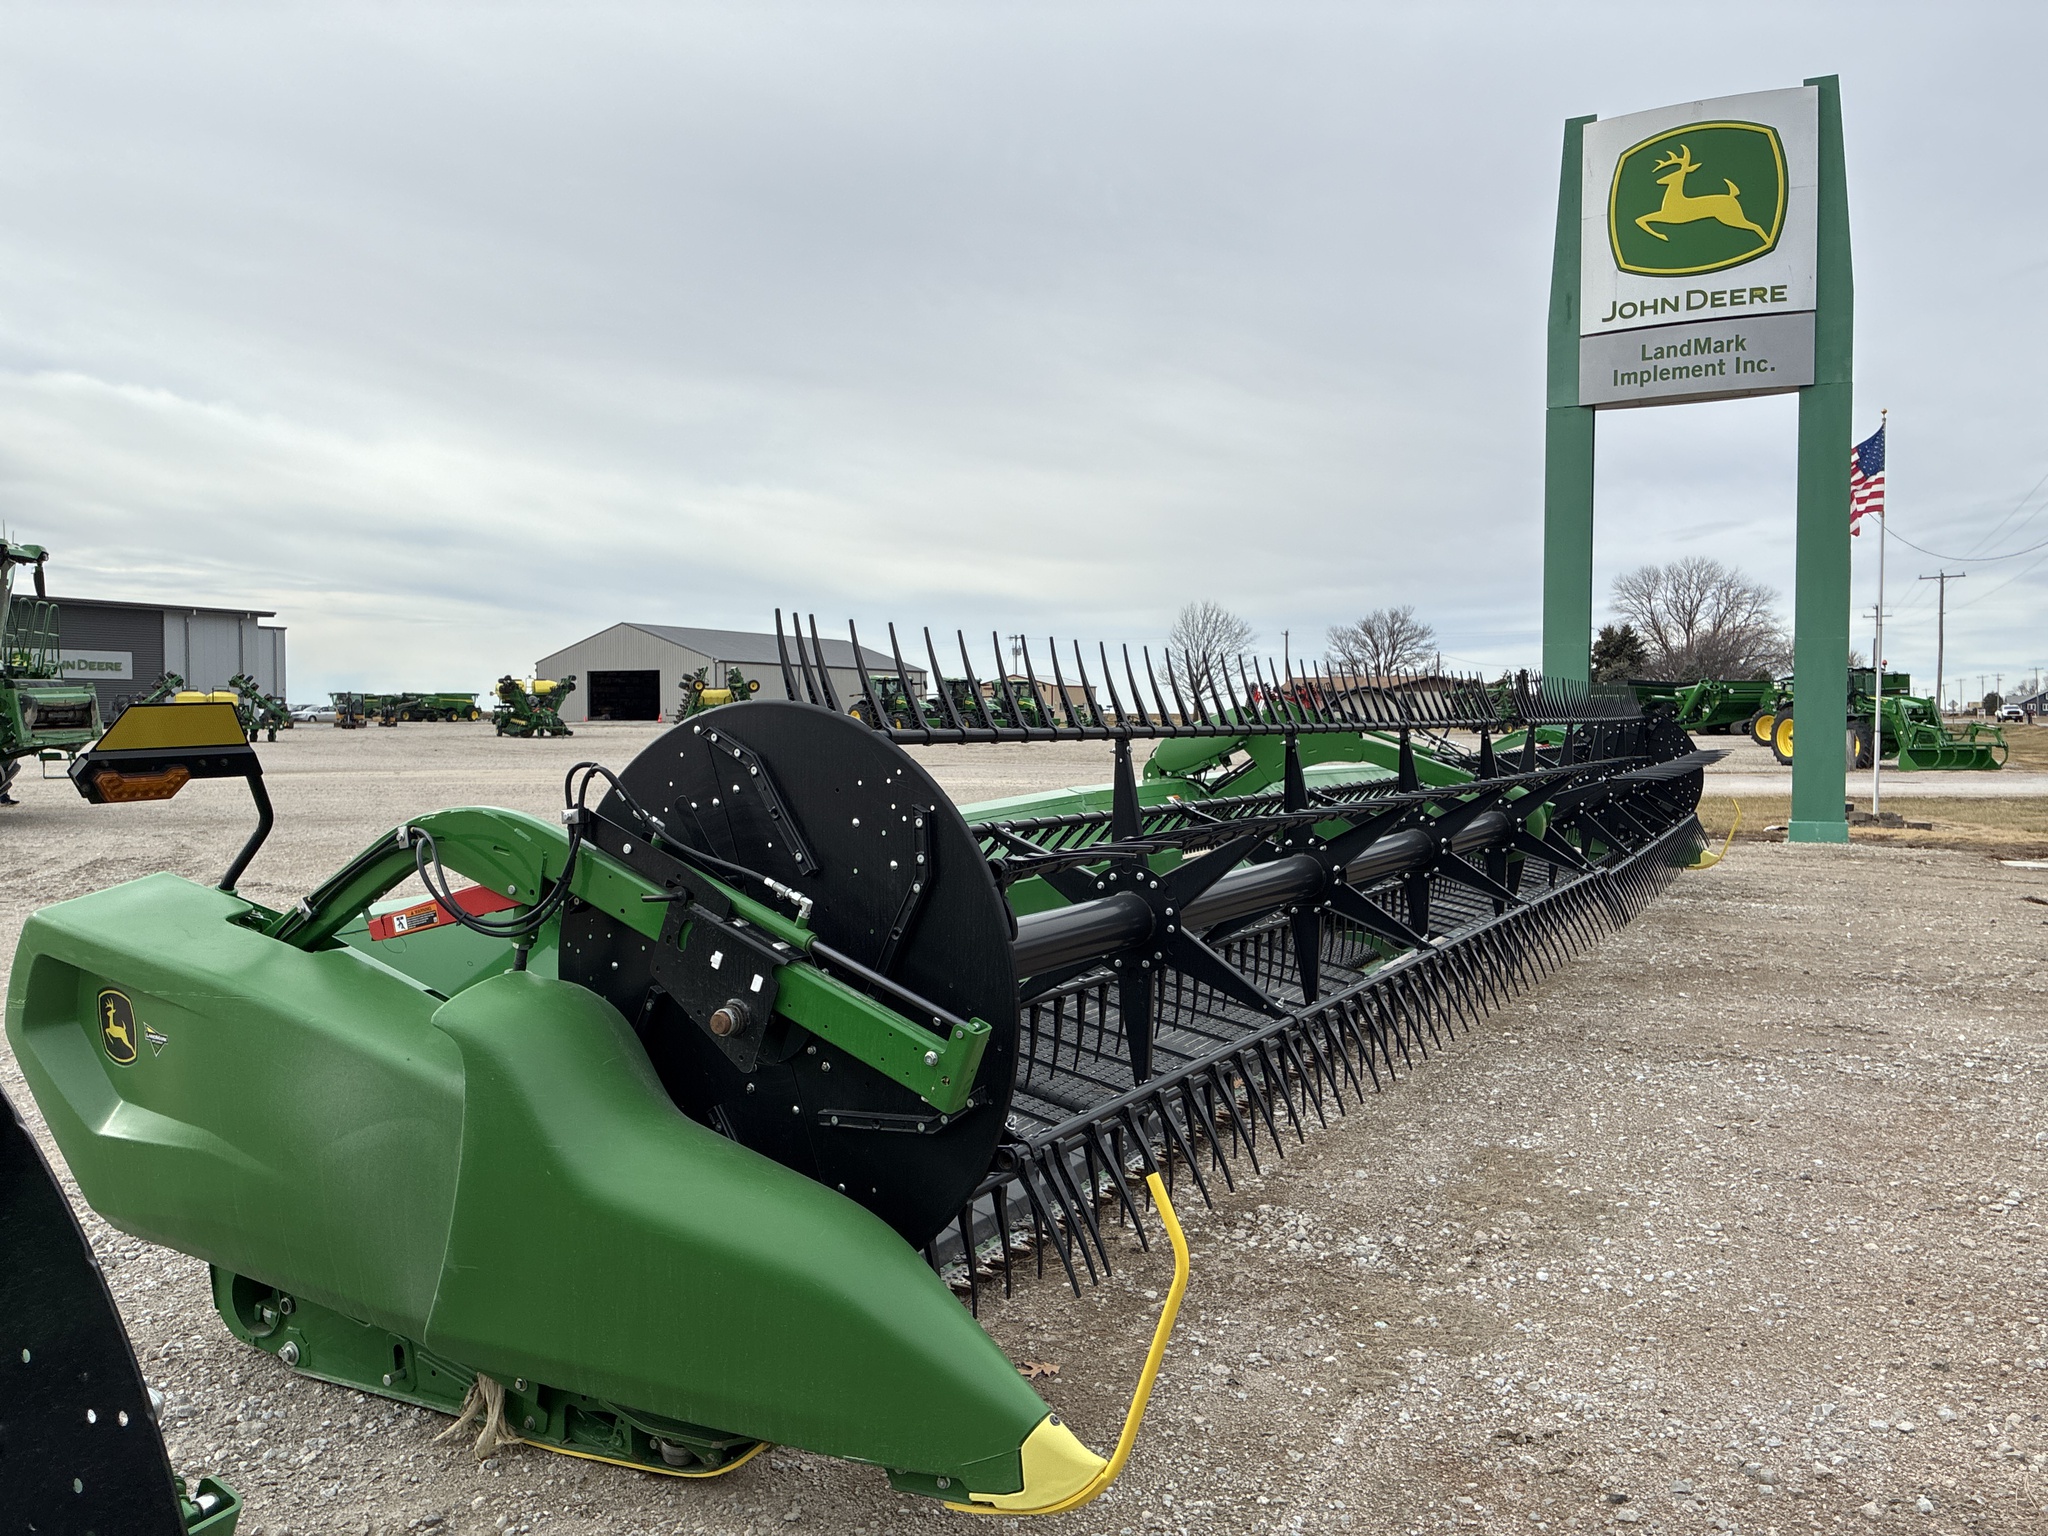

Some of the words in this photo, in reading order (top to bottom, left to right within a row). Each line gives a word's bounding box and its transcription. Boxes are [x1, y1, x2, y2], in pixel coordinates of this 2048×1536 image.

[1602, 296, 1680, 322] JOHN
[1686, 284, 1787, 311] DEERE
[1641, 335, 1747, 361] LandMark
[1613, 360, 1726, 387] Implement
[1735, 356, 1776, 374] Inc.
[78, 659, 122, 671] DEERE
